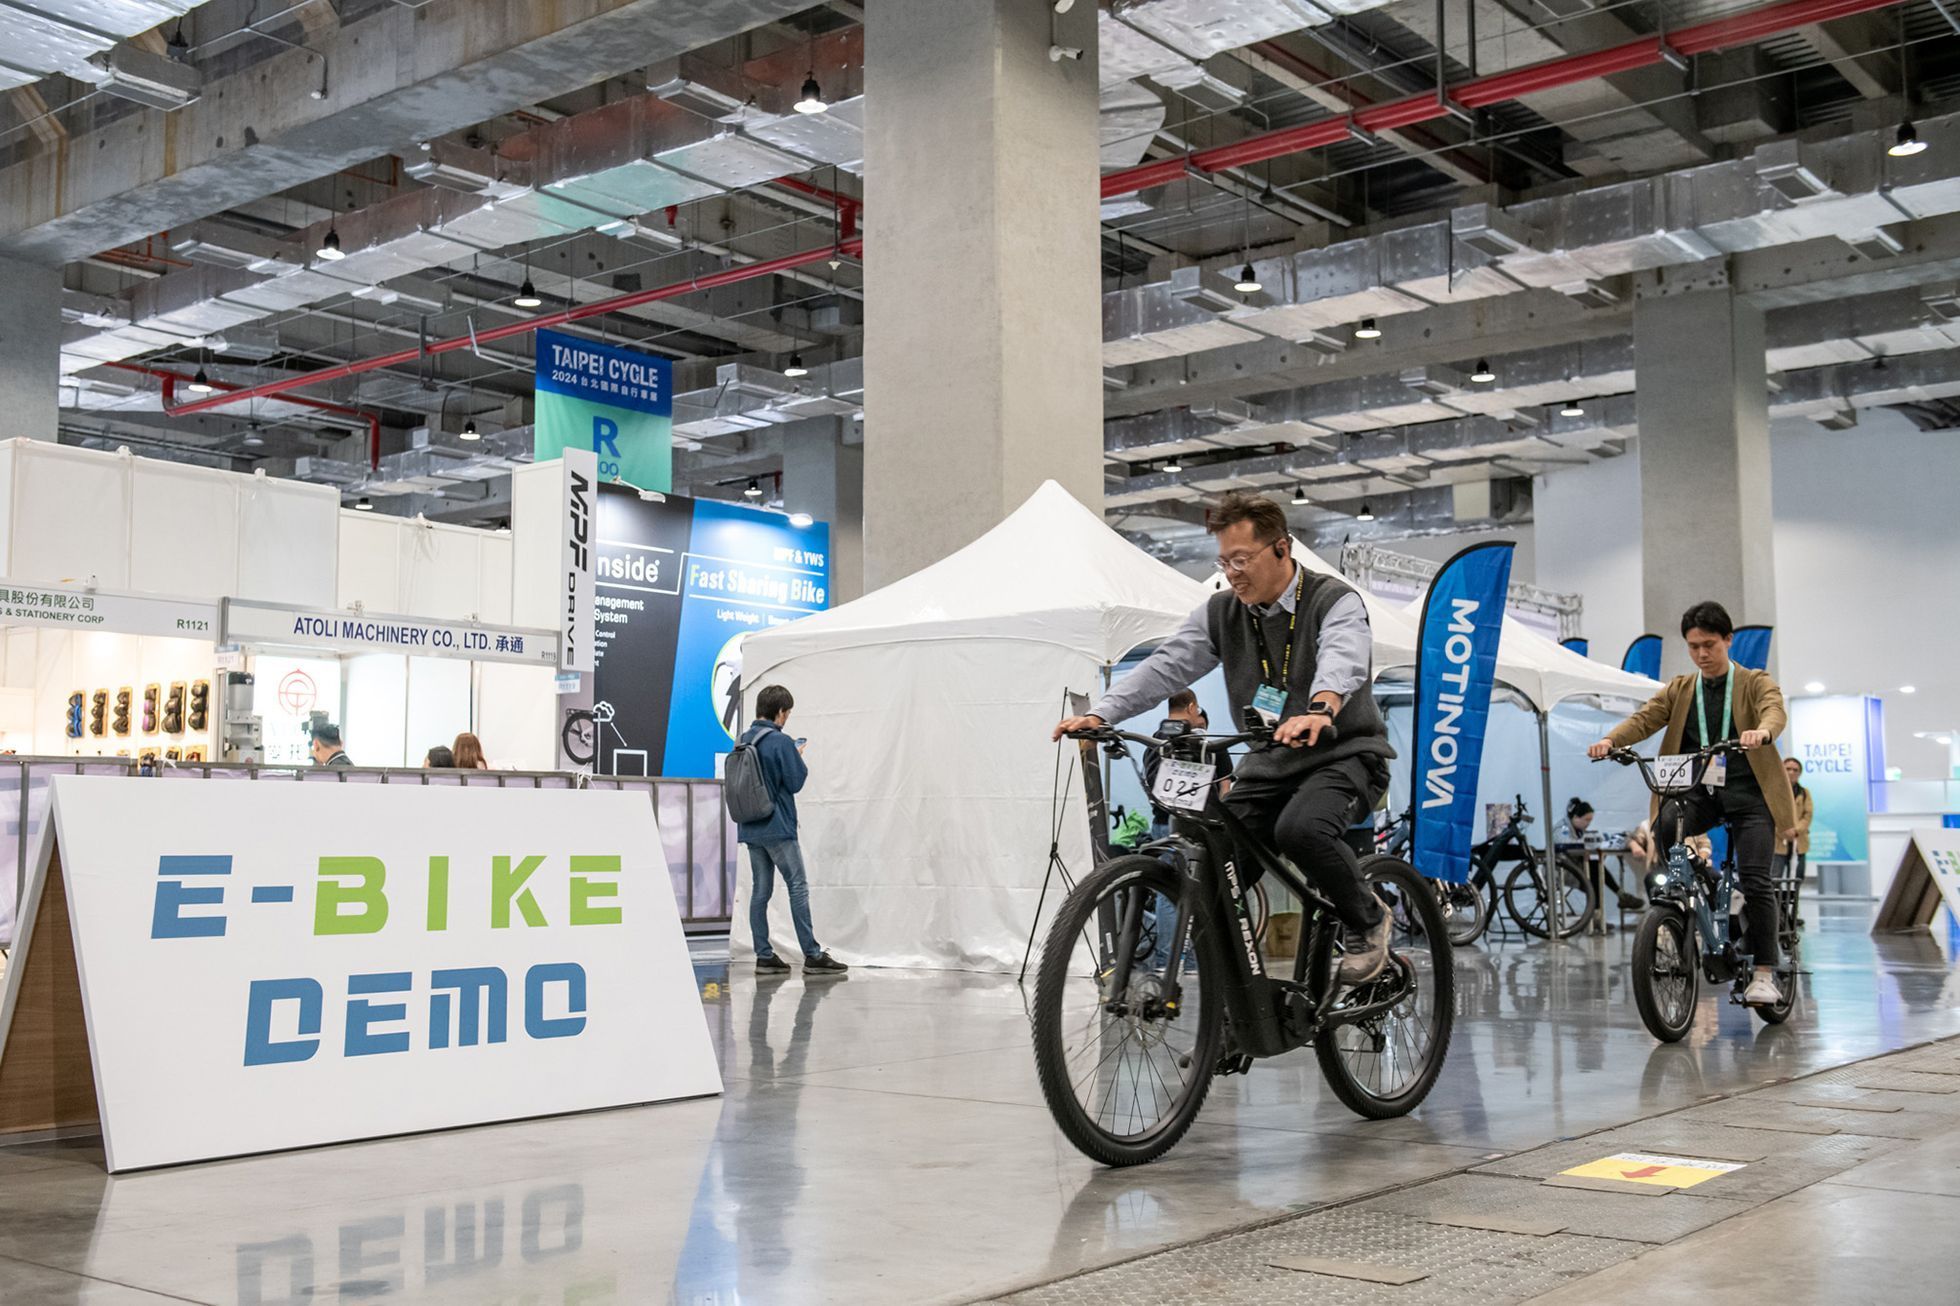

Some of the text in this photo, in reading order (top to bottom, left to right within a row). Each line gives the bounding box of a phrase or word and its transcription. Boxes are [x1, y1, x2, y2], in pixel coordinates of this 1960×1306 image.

[552, 344, 659, 388] TAIPEI CYCLE
[552, 370, 578, 385] 2024
[592, 415, 621, 458] R
[569, 470, 589, 572] MPF
[597, 554, 659, 583] nside
[804, 551, 825, 568] YWS
[689, 564, 725, 590] Fast
[790, 578, 825, 604] Bike
[5, 607, 13, 617] &
[15, 608, 75, 622] STATIONERY
[77, 613, 105, 625] CORP
[566, 572, 576, 665] DRIVE
[594, 596, 645, 611] anagement
[594, 608, 628, 623] System
[176, 618, 210, 632] R1121
[293, 616, 524, 653] ATOLI MACHINERY CO., LTD. 承通
[1421, 598, 1480, 809] MOTINOVA
[1803, 743, 1853, 758] TAIPEI
[1804, 758, 1853, 773] CYCLE
[150, 854, 623, 939] E-BIKE
[1239, 917, 1261, 976] REXON
[243, 961, 587, 1067] DEMO
